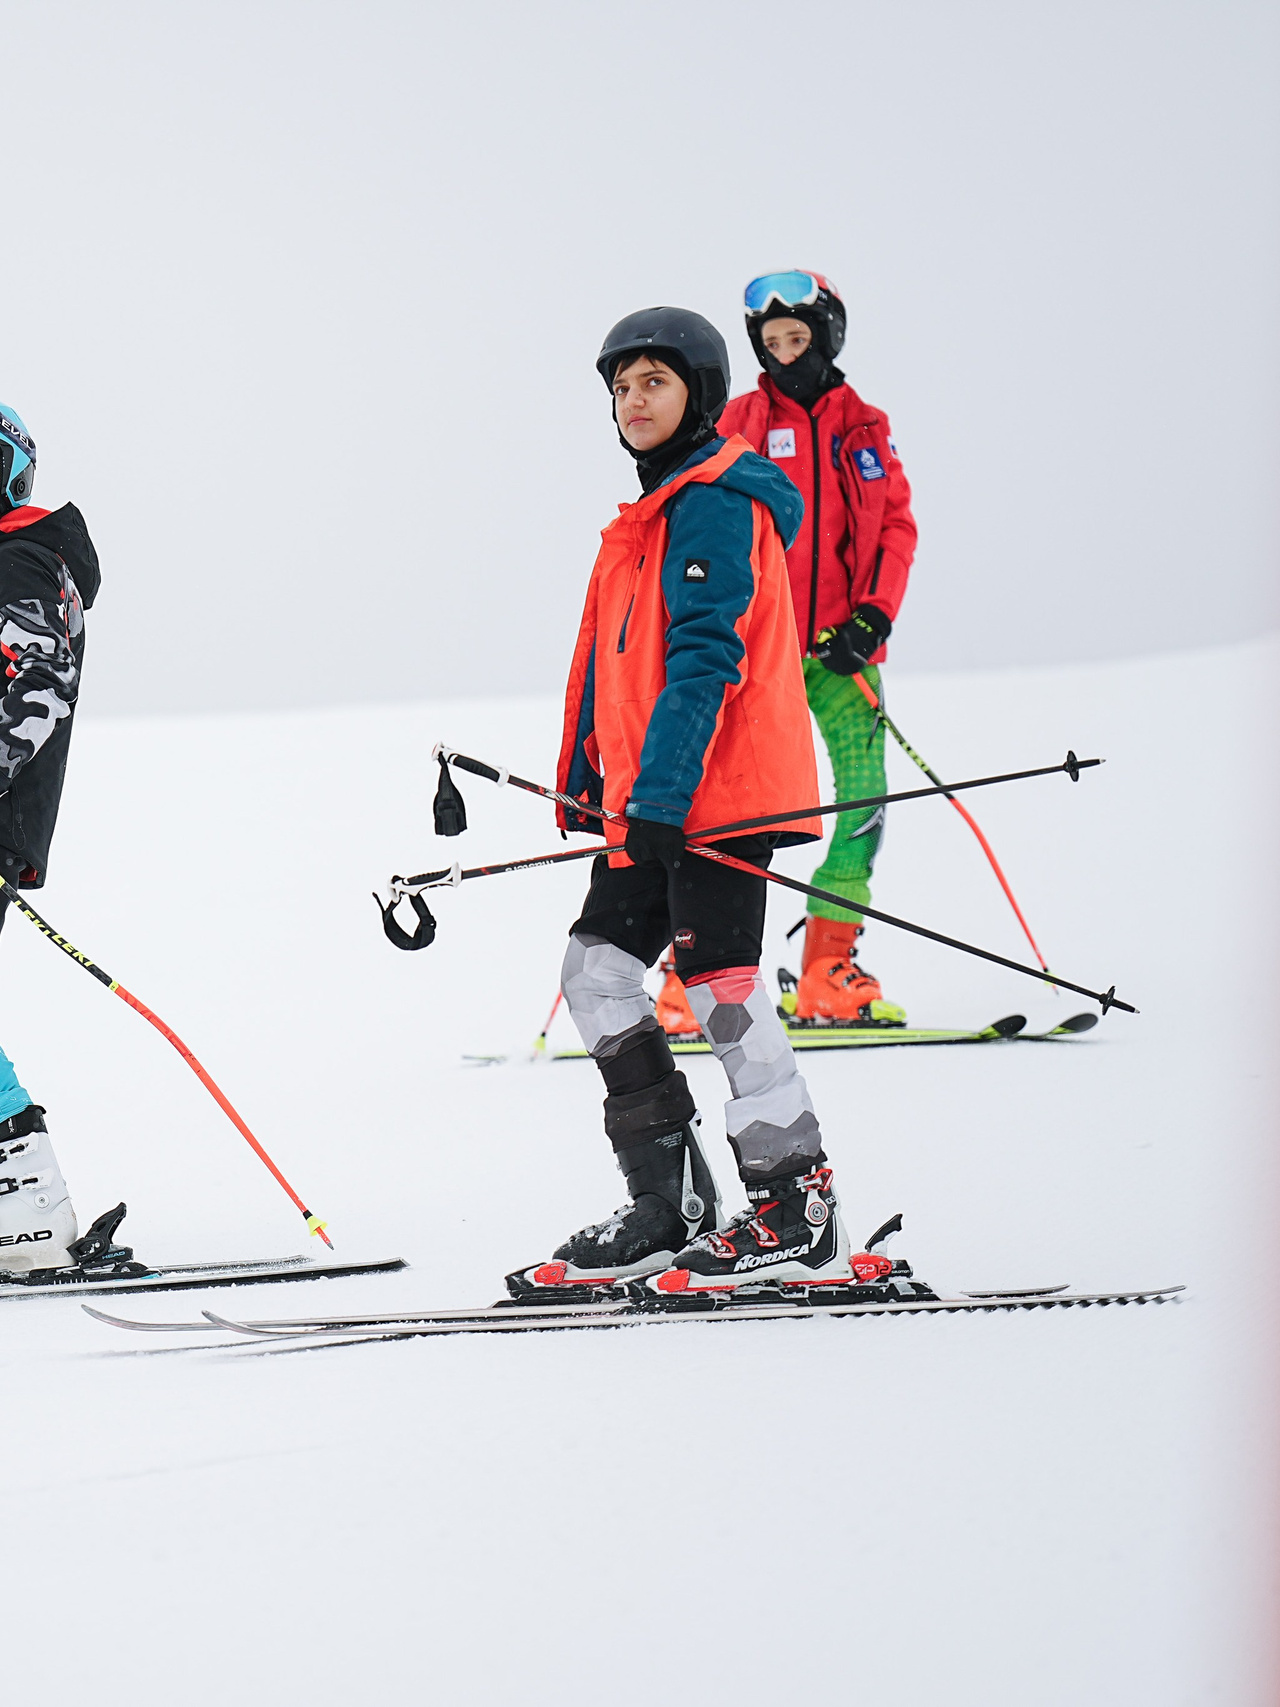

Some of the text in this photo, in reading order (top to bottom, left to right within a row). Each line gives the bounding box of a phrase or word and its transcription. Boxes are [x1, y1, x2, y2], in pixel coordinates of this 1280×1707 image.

[52, 935, 94, 967] LEKI
[102, 1251, 126, 1260] HEAD
[733, 1244, 809, 1272] NORDICA
